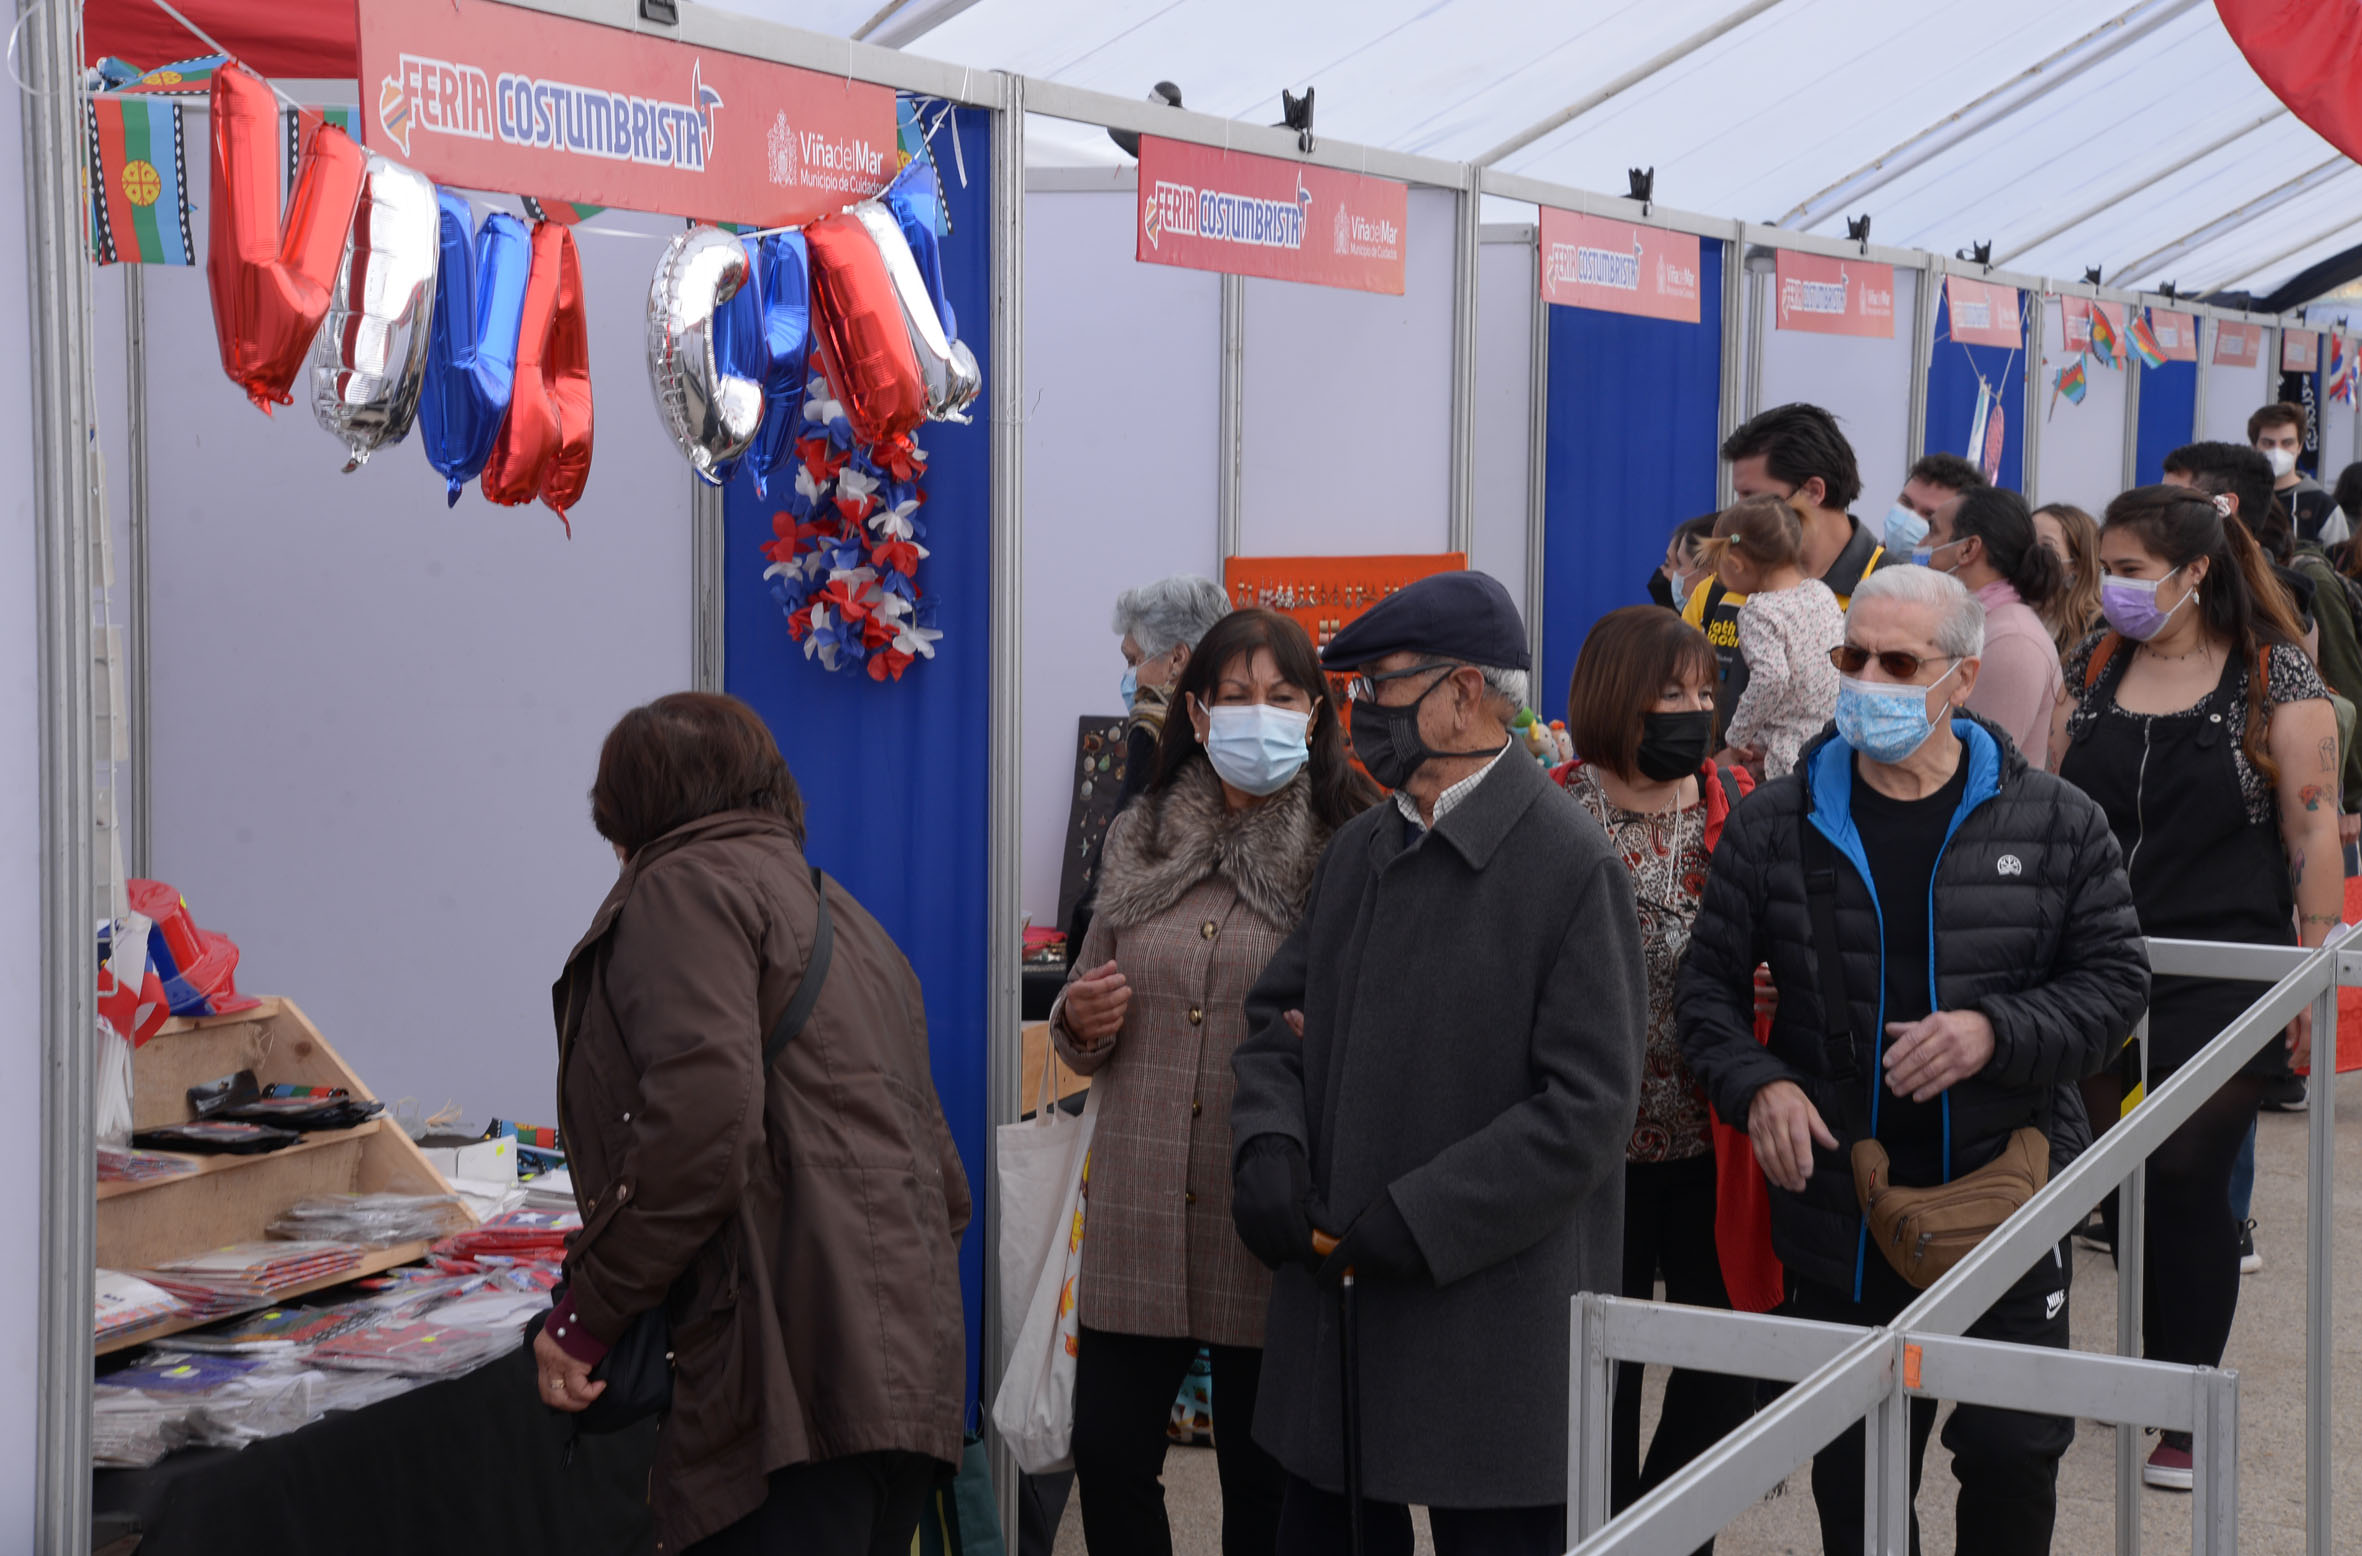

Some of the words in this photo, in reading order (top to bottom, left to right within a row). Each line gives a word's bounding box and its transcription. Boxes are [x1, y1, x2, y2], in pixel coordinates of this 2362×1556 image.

[400, 53, 494, 140] FERIA
[496, 73, 704, 172] COSTUMBRISTA
[800, 168, 838, 193] Municipio
[838, 174, 849, 192] de
[1155, 180, 1197, 236] FERIA
[1199, 189, 1301, 249] COSTUMBRISTA
[1552, 242, 1577, 282] FERIA
[1577, 246, 1638, 291] COSTUMBRISTA
[2046, 1289, 2065, 1309] NIKE
